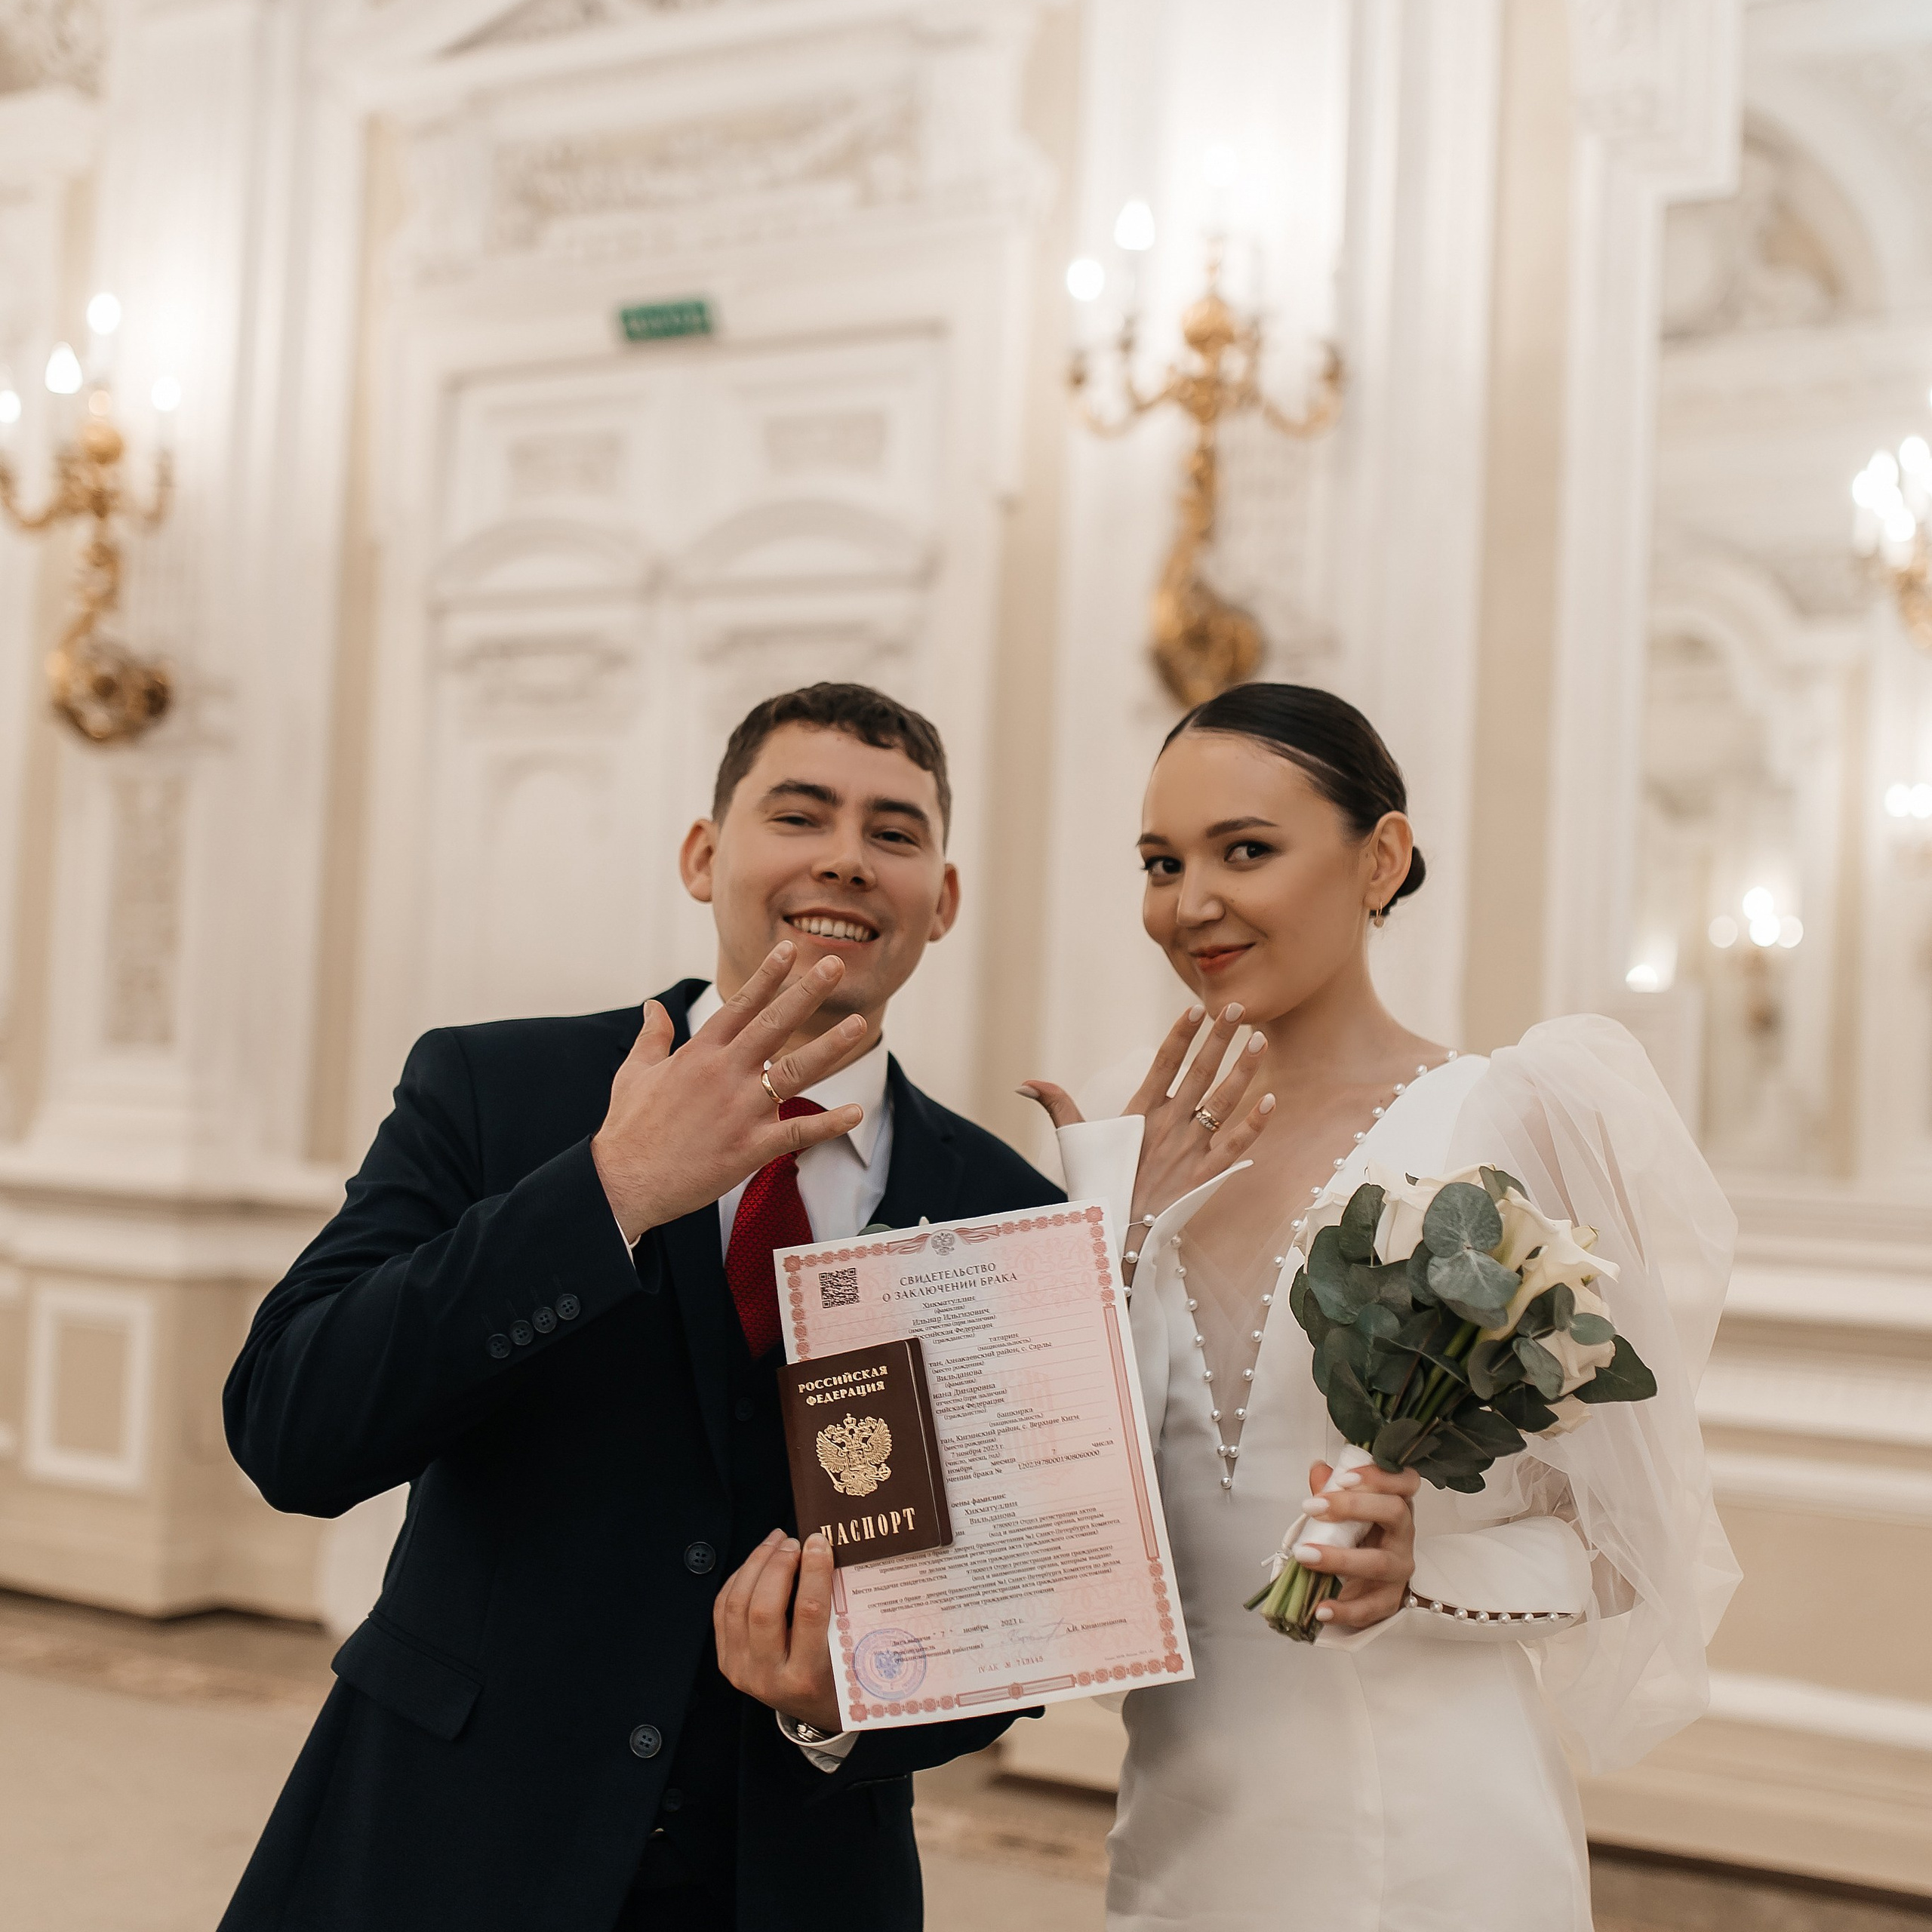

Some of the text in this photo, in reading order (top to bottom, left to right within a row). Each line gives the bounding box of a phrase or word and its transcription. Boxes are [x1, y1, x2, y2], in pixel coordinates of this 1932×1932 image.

[900, 1262, 996, 1287] СВИДЕТЕЛЬСТВО
[882, 1272, 1017, 1303] О ЗАКЛЮЧЕНИИ БРАКА
[954, 1322, 993, 1334] Федерация
[989, 1333, 1019, 1343] татарин
[798, 1365, 888, 1393] РОССИЙСКАЯ
[937, 1369, 983, 1383] Вильданова
[806, 1380, 885, 1406] ФЕДЕРАЦИЯ
[965, 1398, 1004, 1409] Федерация
[996, 1407, 1033, 1419] башкирка
[947, 1465, 973, 1474] ноября
[991, 1458, 1016, 1466] месяца
[1091, 1440, 1113, 1448] числа
[955, 1447, 981, 1457] ноября
[983, 1444, 999, 1453] 2023
[964, 1501, 1018, 1515] Хикматуллин
[970, 1512, 1016, 1524] Вильданова
[820, 1507, 915, 1546] ПАСПОРТ
